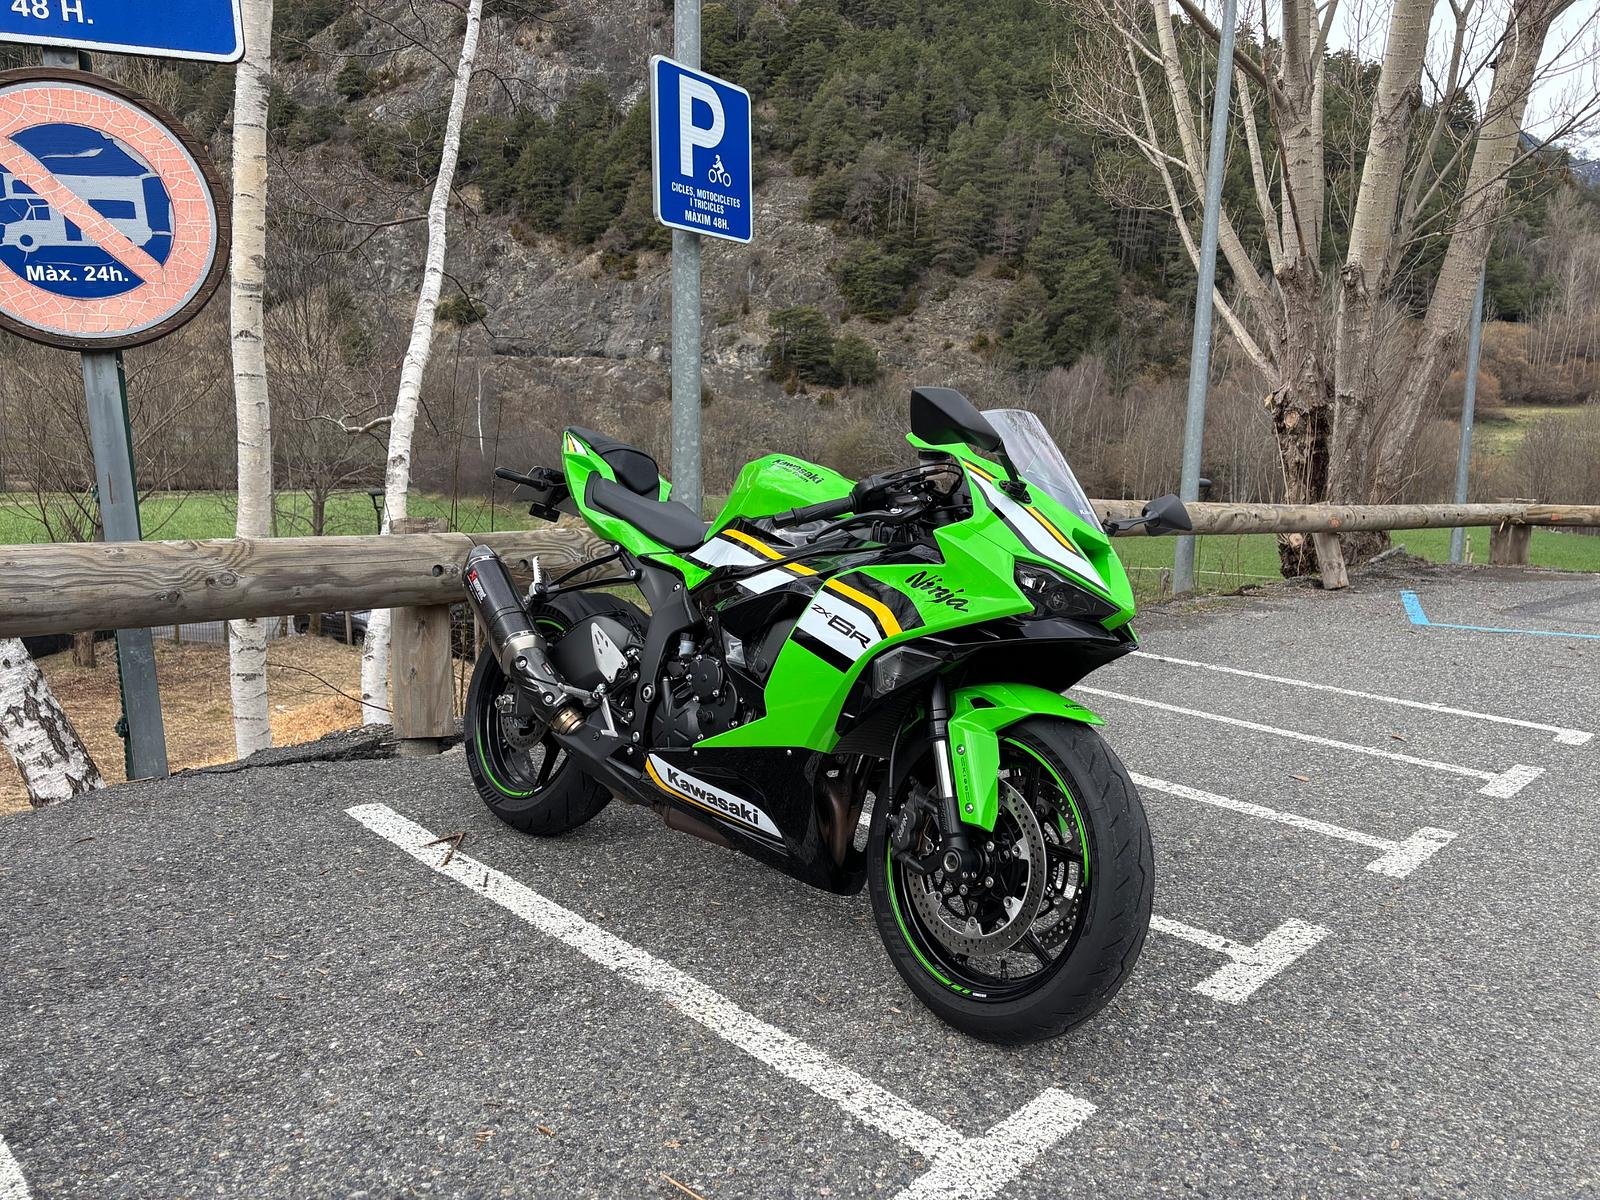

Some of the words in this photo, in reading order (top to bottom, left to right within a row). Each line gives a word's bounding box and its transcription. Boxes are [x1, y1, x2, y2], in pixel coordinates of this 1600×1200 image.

[11, 0, 50, 19] 48
[61, 0, 94, 24] H.
[679, 73, 726, 177] P
[671, 181, 696, 198] CICLES,
[696, 188, 741, 208] MOTOCICLETES
[689, 197, 693, 207] I
[694, 198, 725, 214] TRICICLES
[712, 217, 730, 230] 48H.
[25, 265, 78, 281] Màx.
[83, 265, 129, 281] 24h.
[771, 459, 825, 484] Kawasaki
[905, 570, 969, 613] Ninja
[667, 768, 760, 825] Kawasaki
